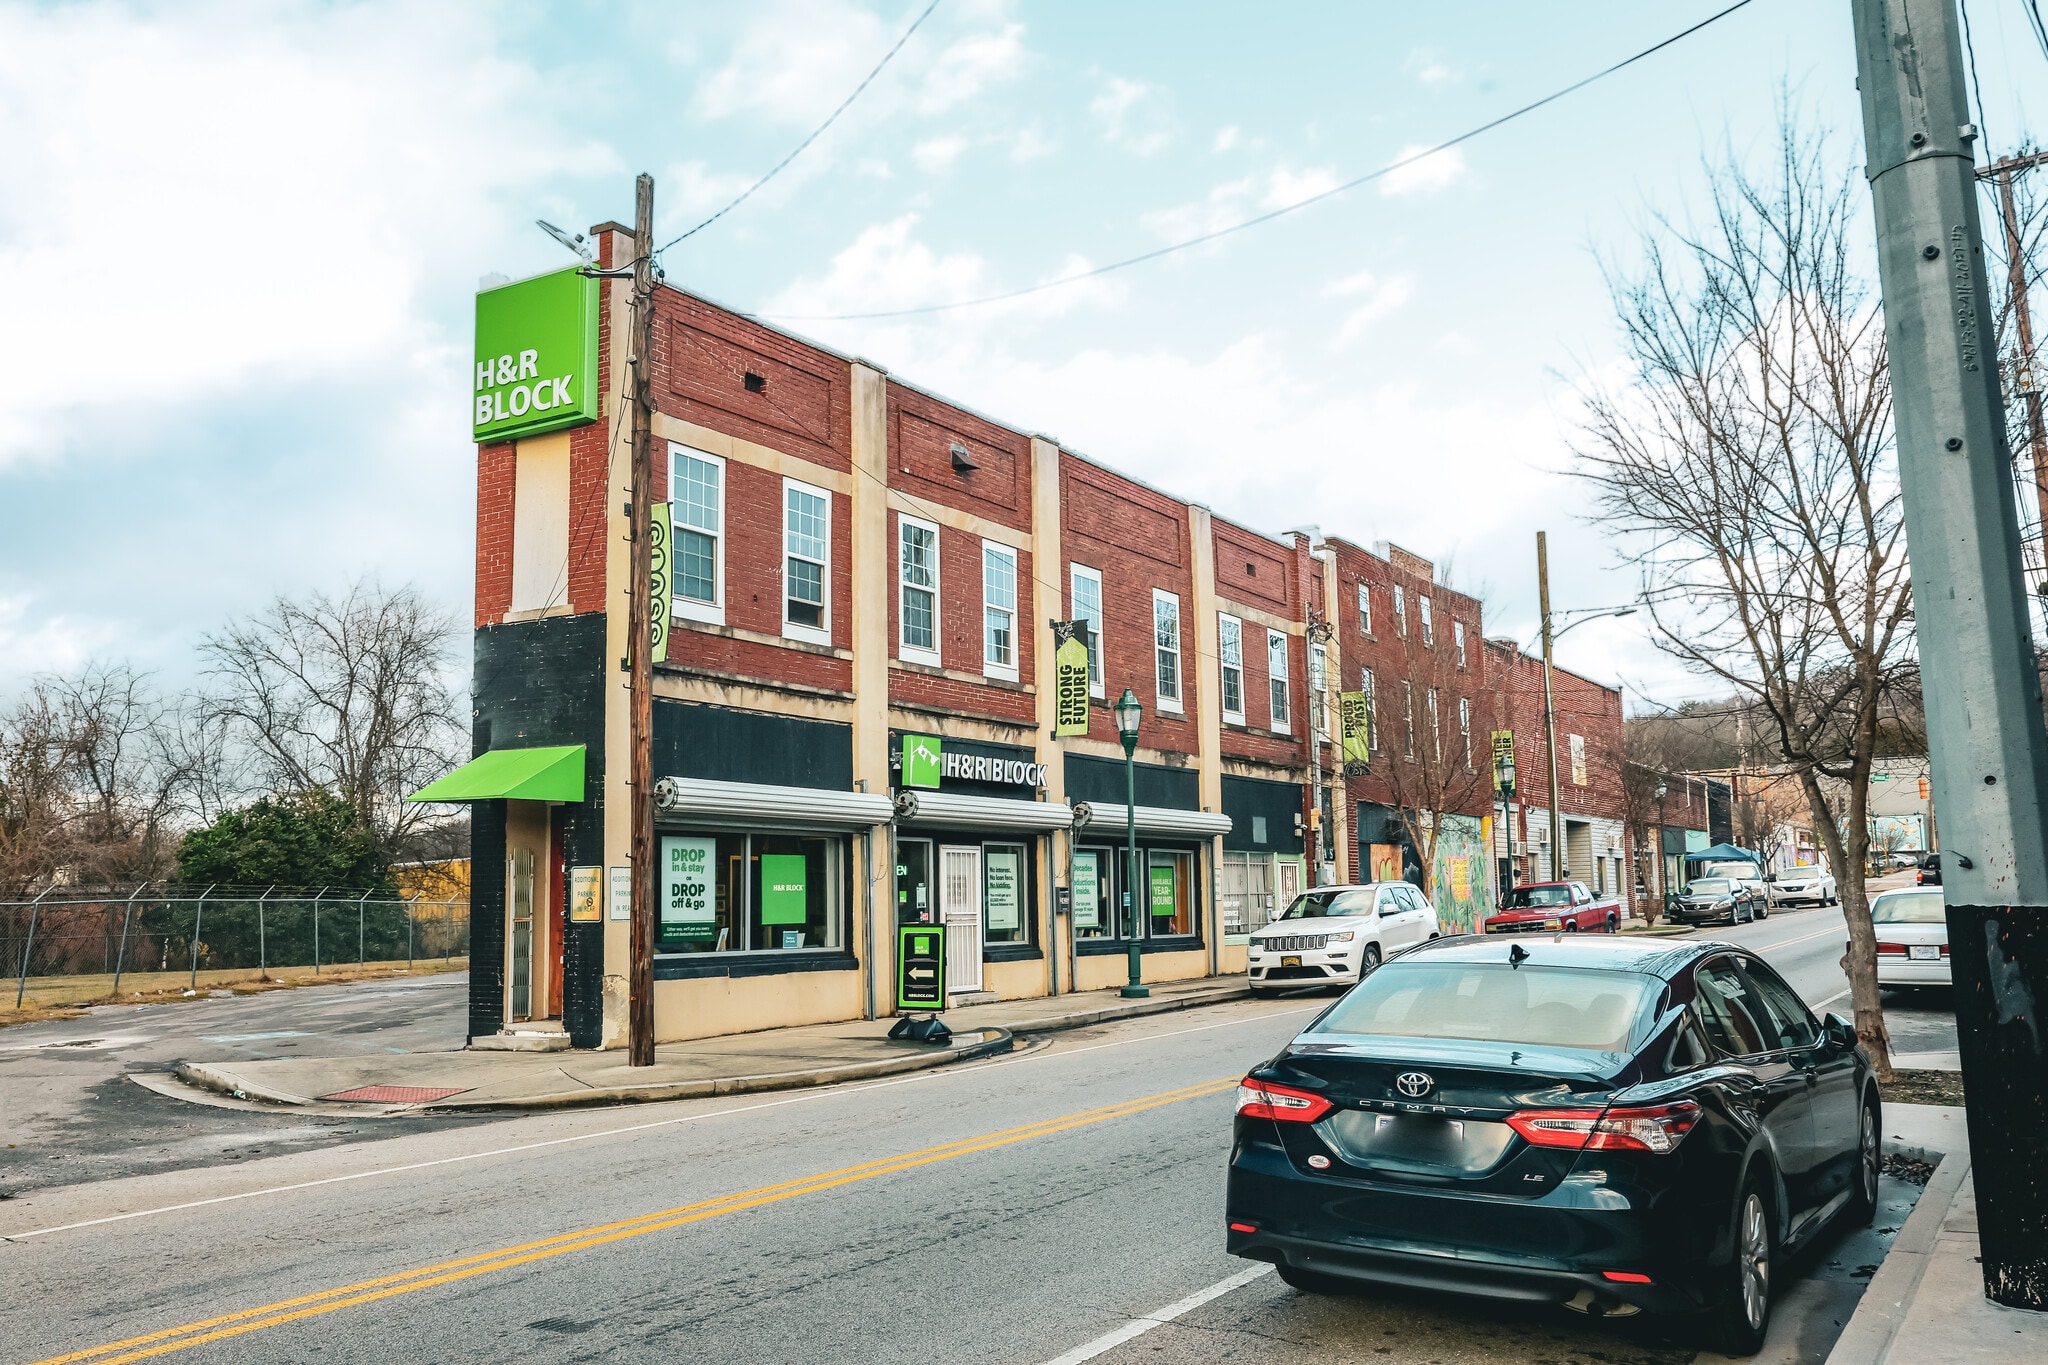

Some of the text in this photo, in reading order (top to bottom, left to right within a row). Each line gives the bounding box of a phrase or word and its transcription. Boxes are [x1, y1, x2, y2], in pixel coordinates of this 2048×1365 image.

[476, 349, 538, 391] H&R
[475, 374, 574, 426] BLOCK
[1059, 664, 1072, 726] STRONG
[1073, 666, 1086, 725] FUTURE
[1343, 700, 1355, 739] PROUD
[1354, 700, 1365, 727] PAST
[946, 752, 1048, 788] H&R BLOCK
[671, 848, 706, 862] DROP
[672, 862, 705, 874] in & stay
[896, 865, 907, 876] EN
[671, 883, 706, 897] DROP
[1153, 886, 1171, 895] YEAR-
[671, 897, 705, 910] off & go
[1152, 896, 1173, 905] ROUND
[1359, 1100, 1474, 1114] CAMRY
[1522, 1173, 1545, 1182] LE
